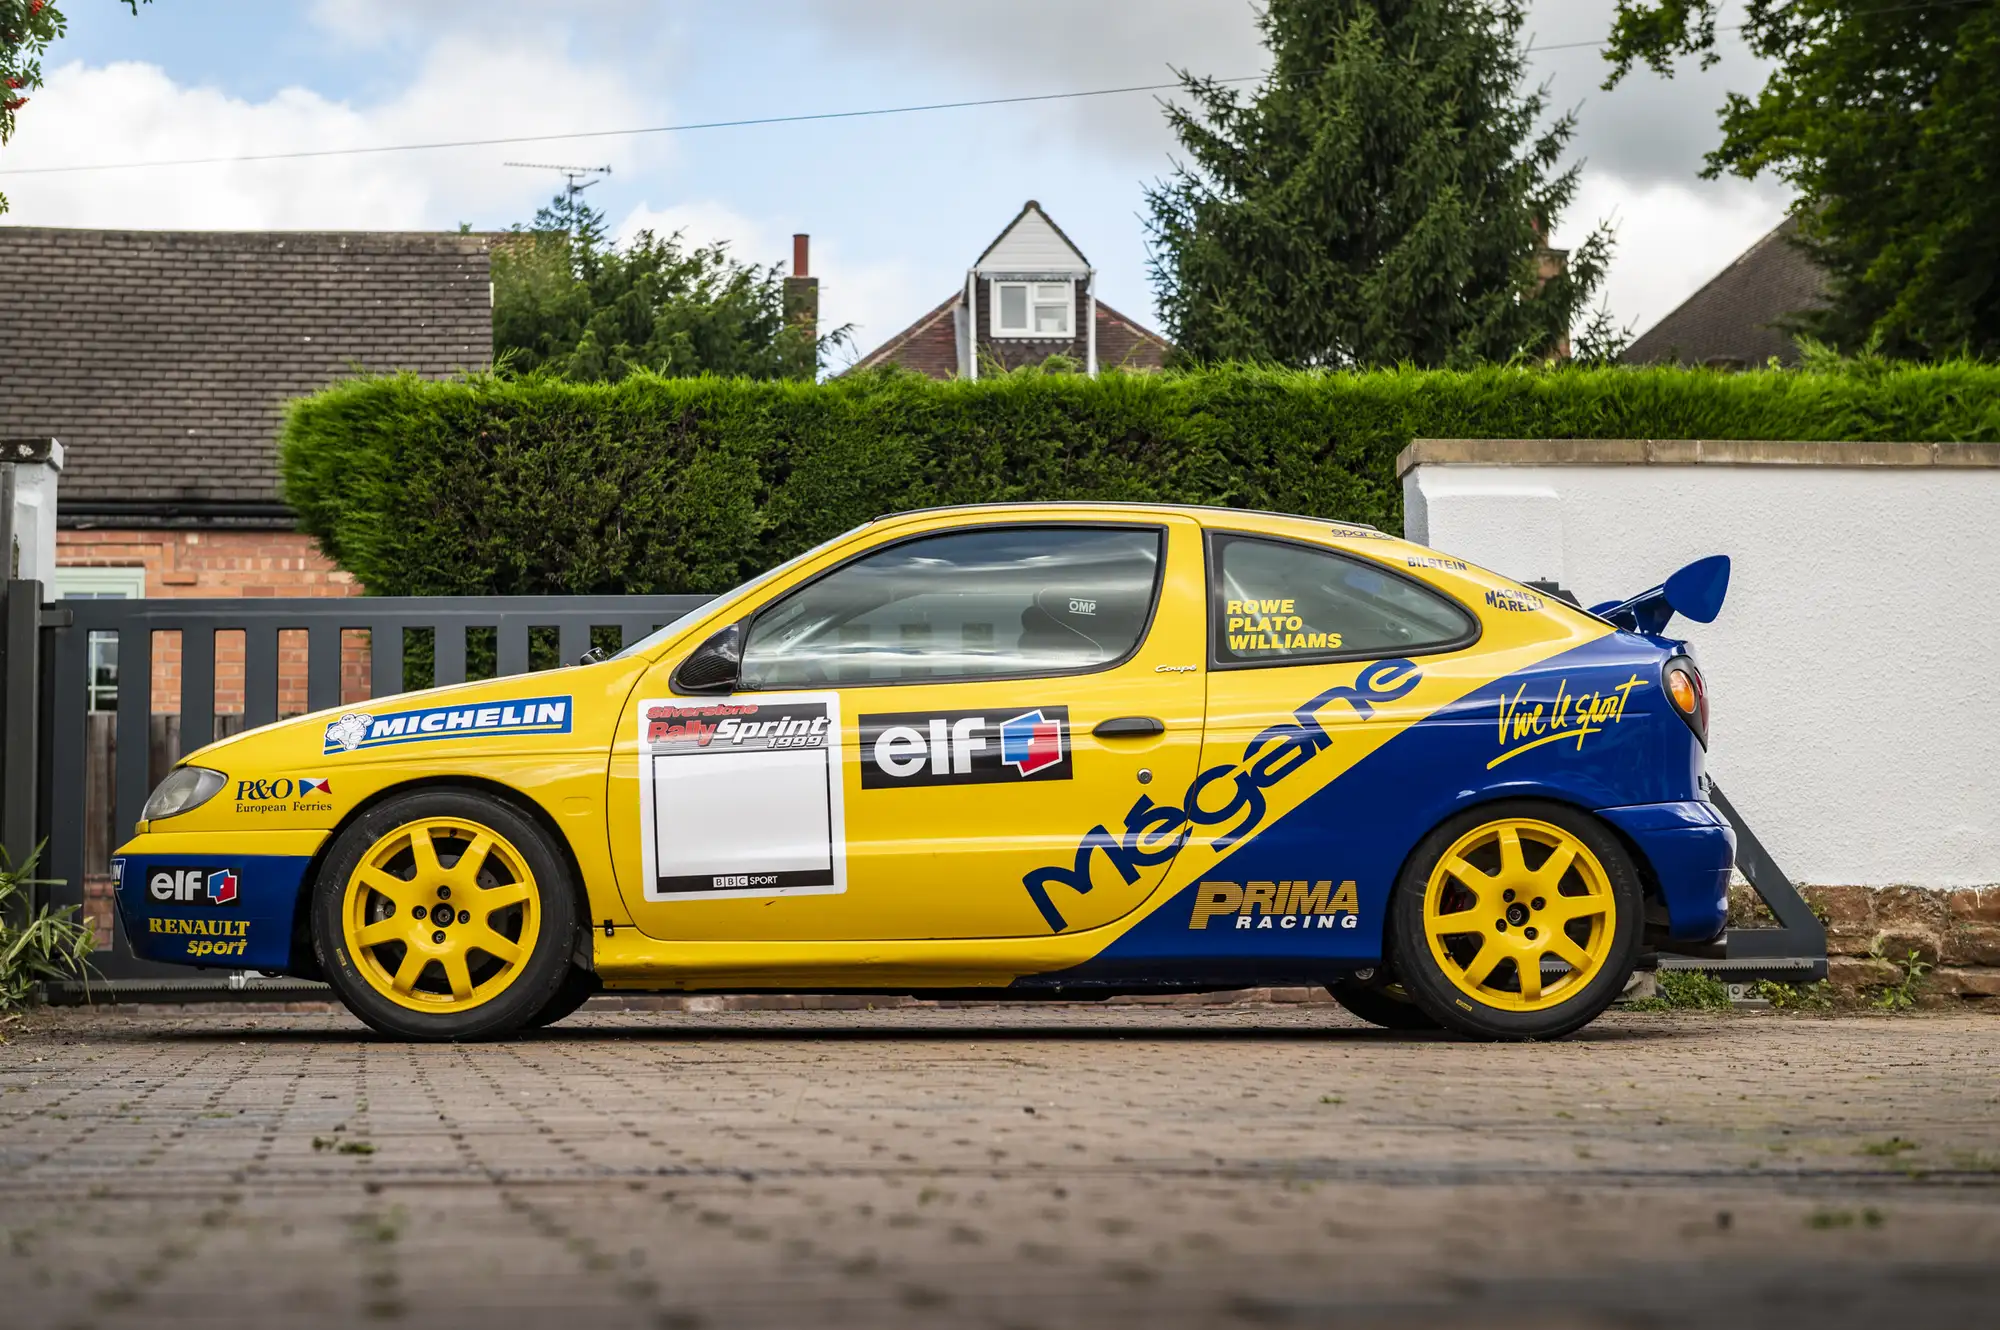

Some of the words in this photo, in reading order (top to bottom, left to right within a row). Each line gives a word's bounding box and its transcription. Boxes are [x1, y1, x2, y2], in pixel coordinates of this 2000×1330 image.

[1407, 556, 1467, 571] BILSTEIN
[1069, 600, 1096, 613] OMP
[1227, 599, 1295, 615] ROWE
[1228, 616, 1303, 632] PLATO
[1229, 633, 1343, 650] WILLIAMS
[371, 702, 566, 738] MICHELIN
[646, 703, 759, 720] Silverstone
[1499, 682, 1547, 745] Vive
[1550, 678, 1572, 729] le
[767, 735, 823, 749] 1999
[874, 717, 986, 777] elf
[234, 778, 294, 801] P&O
[1022, 658, 1424, 934] Mégane
[236, 802, 287, 815] European
[293, 801, 333, 812] Ferries
[150, 870, 202, 901] elf
[713, 875, 748, 888] BBC
[749, 875, 778, 885] SPORT
[1188, 880, 1360, 930] PRIMA
[148, 917, 251, 937] RENAULT
[1235, 915, 1358, 929] RACING
[186, 939, 248, 956] sport
